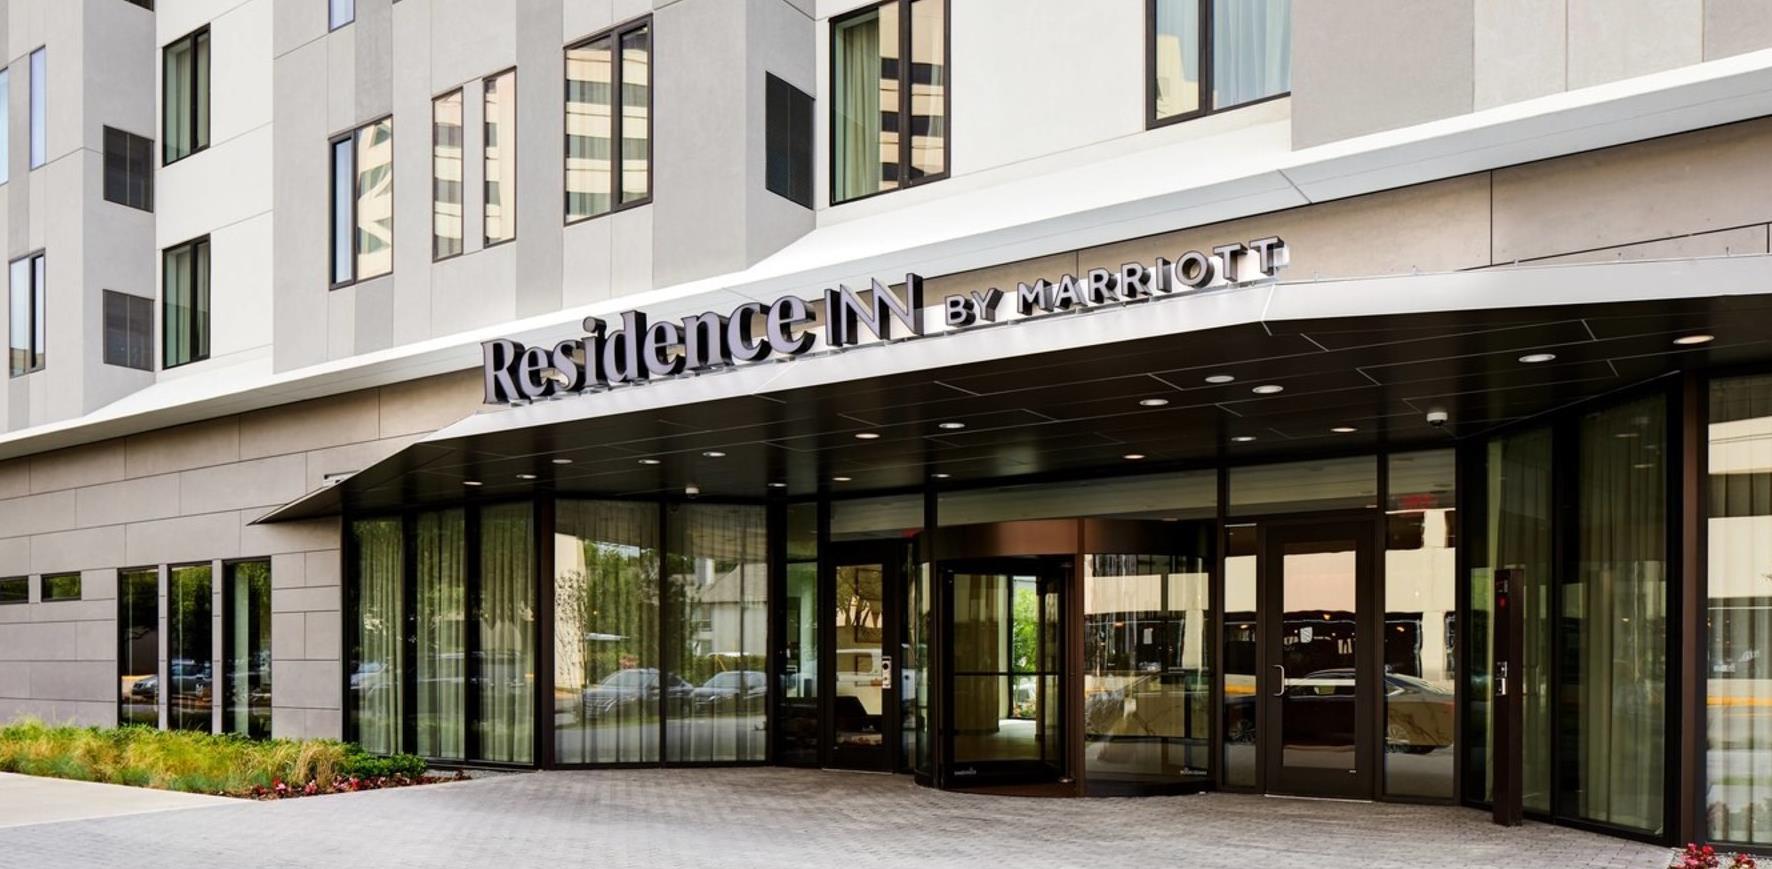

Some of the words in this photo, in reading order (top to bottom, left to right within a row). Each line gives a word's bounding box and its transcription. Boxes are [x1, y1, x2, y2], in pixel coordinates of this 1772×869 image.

[481, 295, 816, 404] Residence
[824, 273, 924, 347] INN
[945, 288, 1004, 327] BY
[1017, 235, 1285, 316] MARRIOTT
